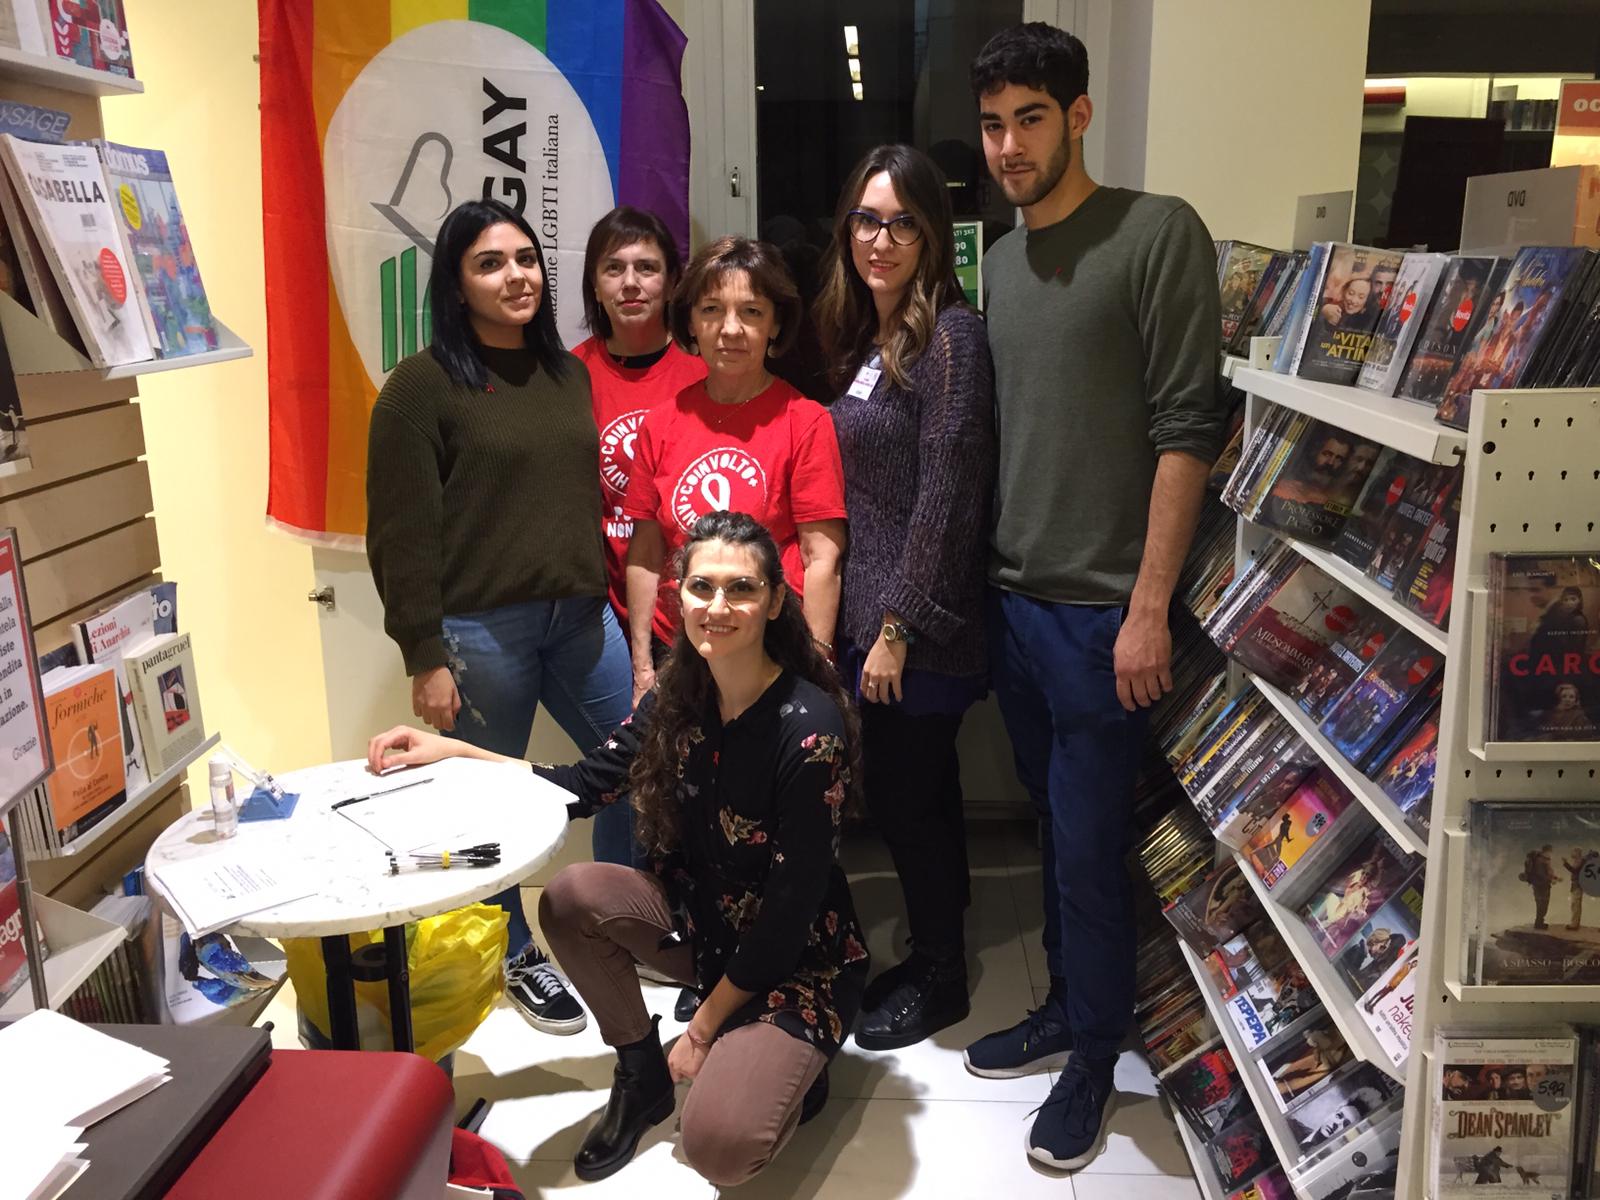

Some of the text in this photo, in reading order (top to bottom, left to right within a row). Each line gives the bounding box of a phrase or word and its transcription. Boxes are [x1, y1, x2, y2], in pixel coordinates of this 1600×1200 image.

[542, 113, 559, 181] italiana
[541, 185, 558, 251] LGBTI
[1340, 333, 1374, 349] VITA
[607, 522, 634, 537] NON
[141, 636, 191, 674] pantagruel
[1254, 625, 1314, 669] MIDSOMMAR
[52, 687, 108, 729] formiche
[12, 735, 38, 762] Grazie
[1235, 995, 1268, 1046] TEPEPA
[1450, 1107, 1560, 1139] DEAN SPANLEY
